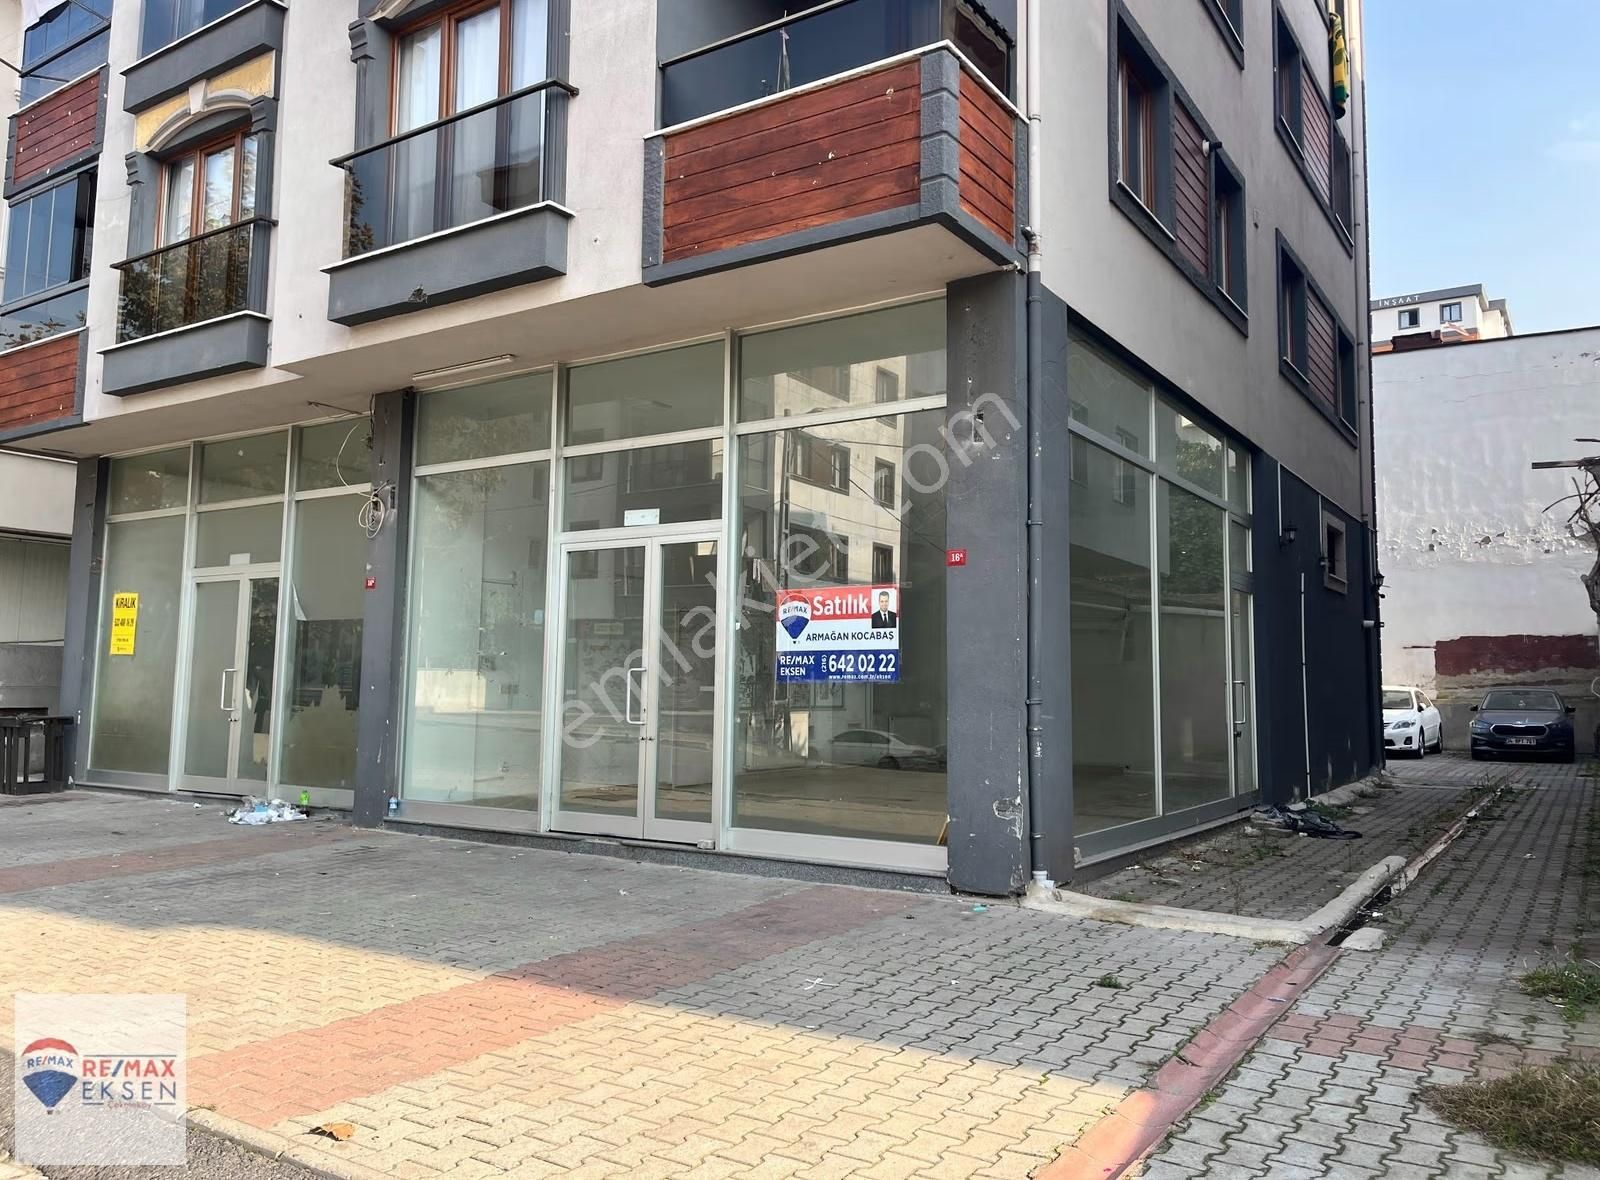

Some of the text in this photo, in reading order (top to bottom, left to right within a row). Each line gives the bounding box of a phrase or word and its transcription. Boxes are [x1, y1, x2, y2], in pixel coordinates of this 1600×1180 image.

[782, 604, 808, 615] RE/MAX
[813, 593, 869, 616] Satılık
[806, 630, 895, 641] ARMAĞAN KOCABAŞ
[780, 655, 815, 666] RE/MAX
[829, 654, 854, 672] 642
[858, 653, 876, 672] 02
[878, 653, 896, 672] 22
[780, 667, 806, 676] EKSEN
